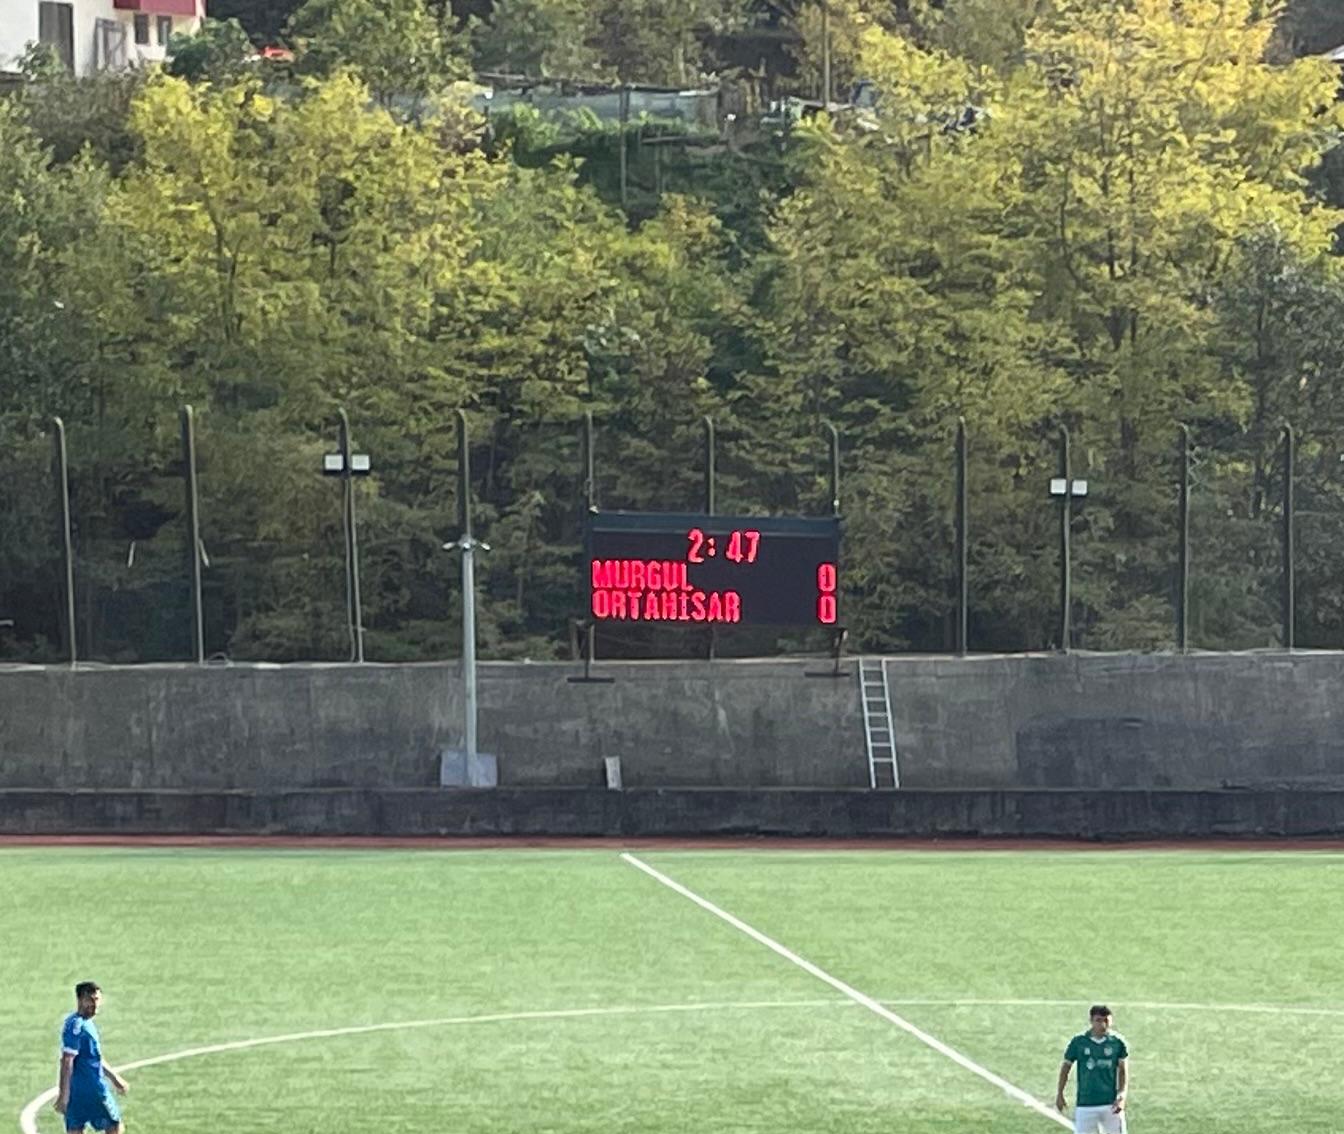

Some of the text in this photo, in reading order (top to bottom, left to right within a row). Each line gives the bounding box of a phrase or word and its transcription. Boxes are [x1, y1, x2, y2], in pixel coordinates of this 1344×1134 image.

[592, 560, 837, 592] MURGUL 0
[592, 590, 837, 624] ORTAHISAR 0
